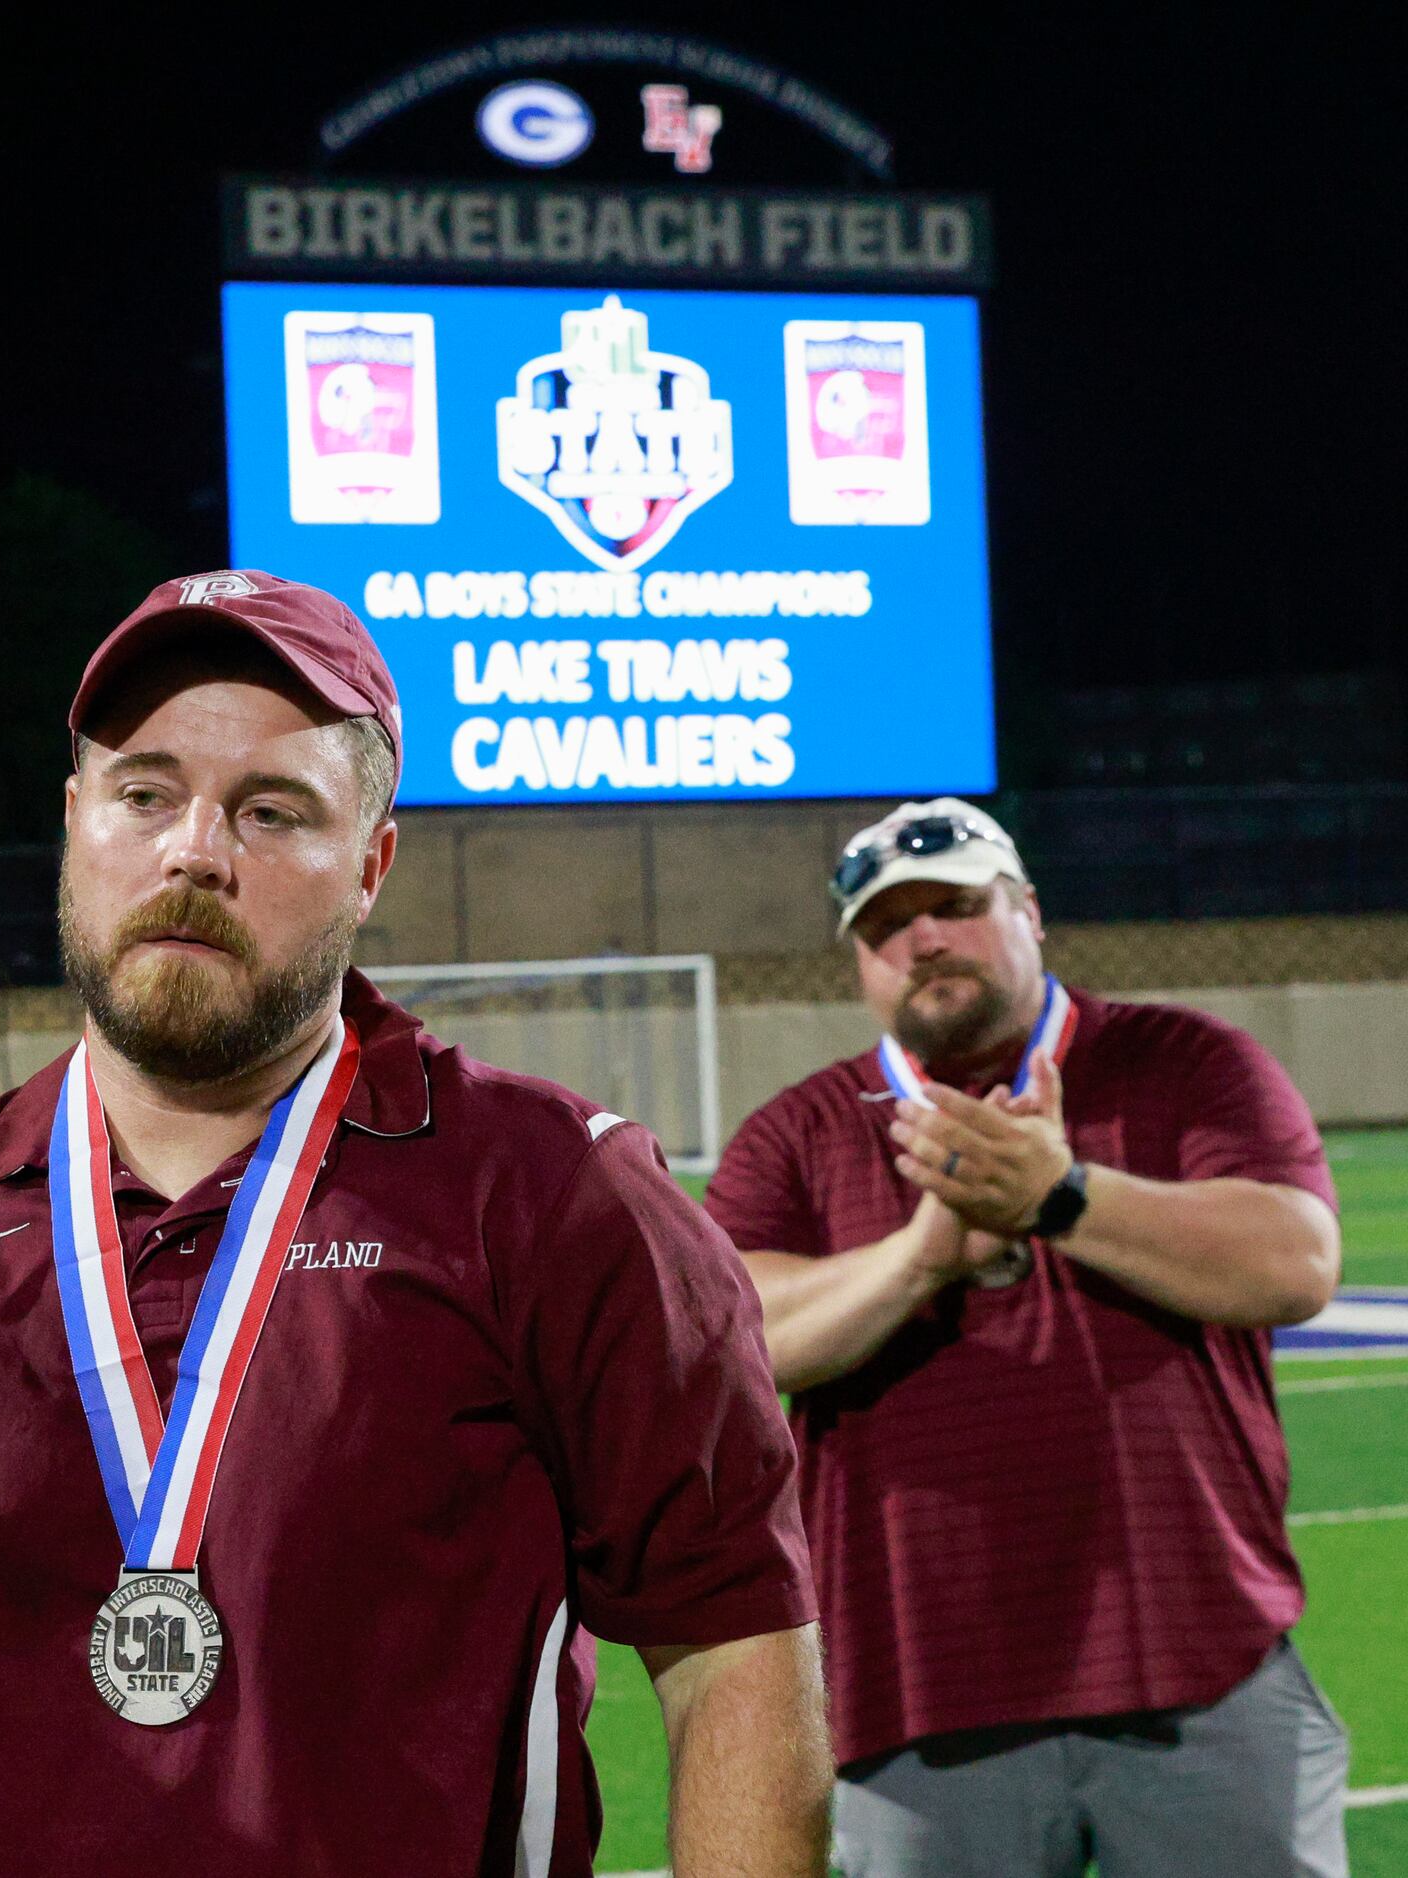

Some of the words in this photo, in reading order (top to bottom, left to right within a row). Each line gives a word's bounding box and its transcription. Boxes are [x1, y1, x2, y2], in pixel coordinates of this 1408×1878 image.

[478, 79, 593, 169] G
[248, 188, 743, 266] BIRKELBACH
[763, 203, 973, 272] FIELD
[425, 571, 529, 618] BOYS
[529, 571, 642, 618] STATE
[642, 571, 872, 618] CHAMPIONS
[453, 640, 592, 704] LAKE
[596, 639, 793, 701] TRAVIS
[451, 714, 795, 790] CAVALIERS
[284, 1241, 383, 1271] PLANO
[90, 1619, 123, 1711] UNIVERSITY
[108, 1578, 219, 1637] INTERSCHOLASTIC
[183, 1647, 220, 1708] LEAGUE
[114, 1604, 195, 1673] UIL
[126, 1673, 179, 1692] STATE
